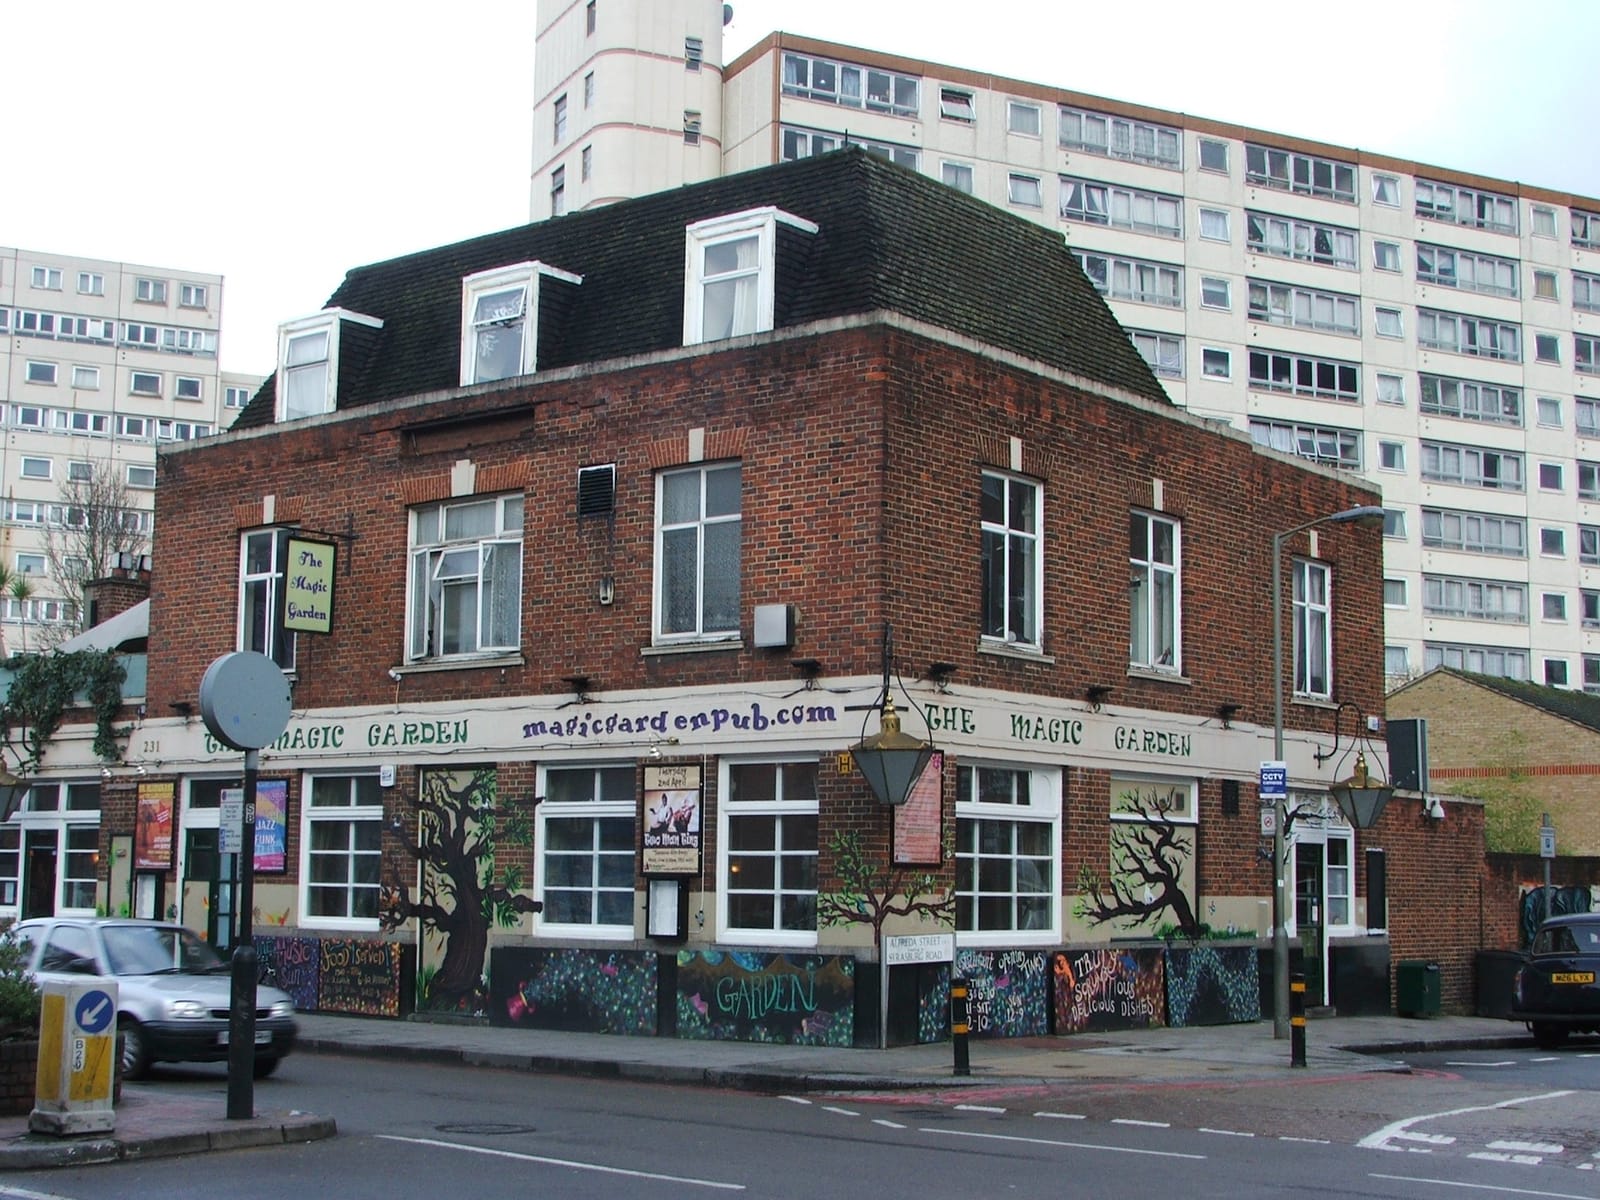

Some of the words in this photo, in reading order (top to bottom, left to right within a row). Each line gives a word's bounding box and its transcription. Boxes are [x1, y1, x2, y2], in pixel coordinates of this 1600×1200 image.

[299, 551, 323, 568] The
[291, 575, 328, 595] Magic
[288, 602, 327, 621] Garden
[523, 702, 837, 739] magicgardenpub.com
[367, 718, 469, 747] GARDEN
[924, 703, 976, 735] THE
[1010, 713, 1083, 746] MAGIC
[1115, 725, 1192, 758] GARDEN
[143, 740, 160, 753] 231
[840, 756, 850, 772] H
[256, 820, 276, 831] JAZZ
[255, 834, 276, 845] FUNK
[919, 936, 941, 946] STREET
[925, 951, 943, 961] ROAD
[716, 973, 818, 1020] GARDEN
